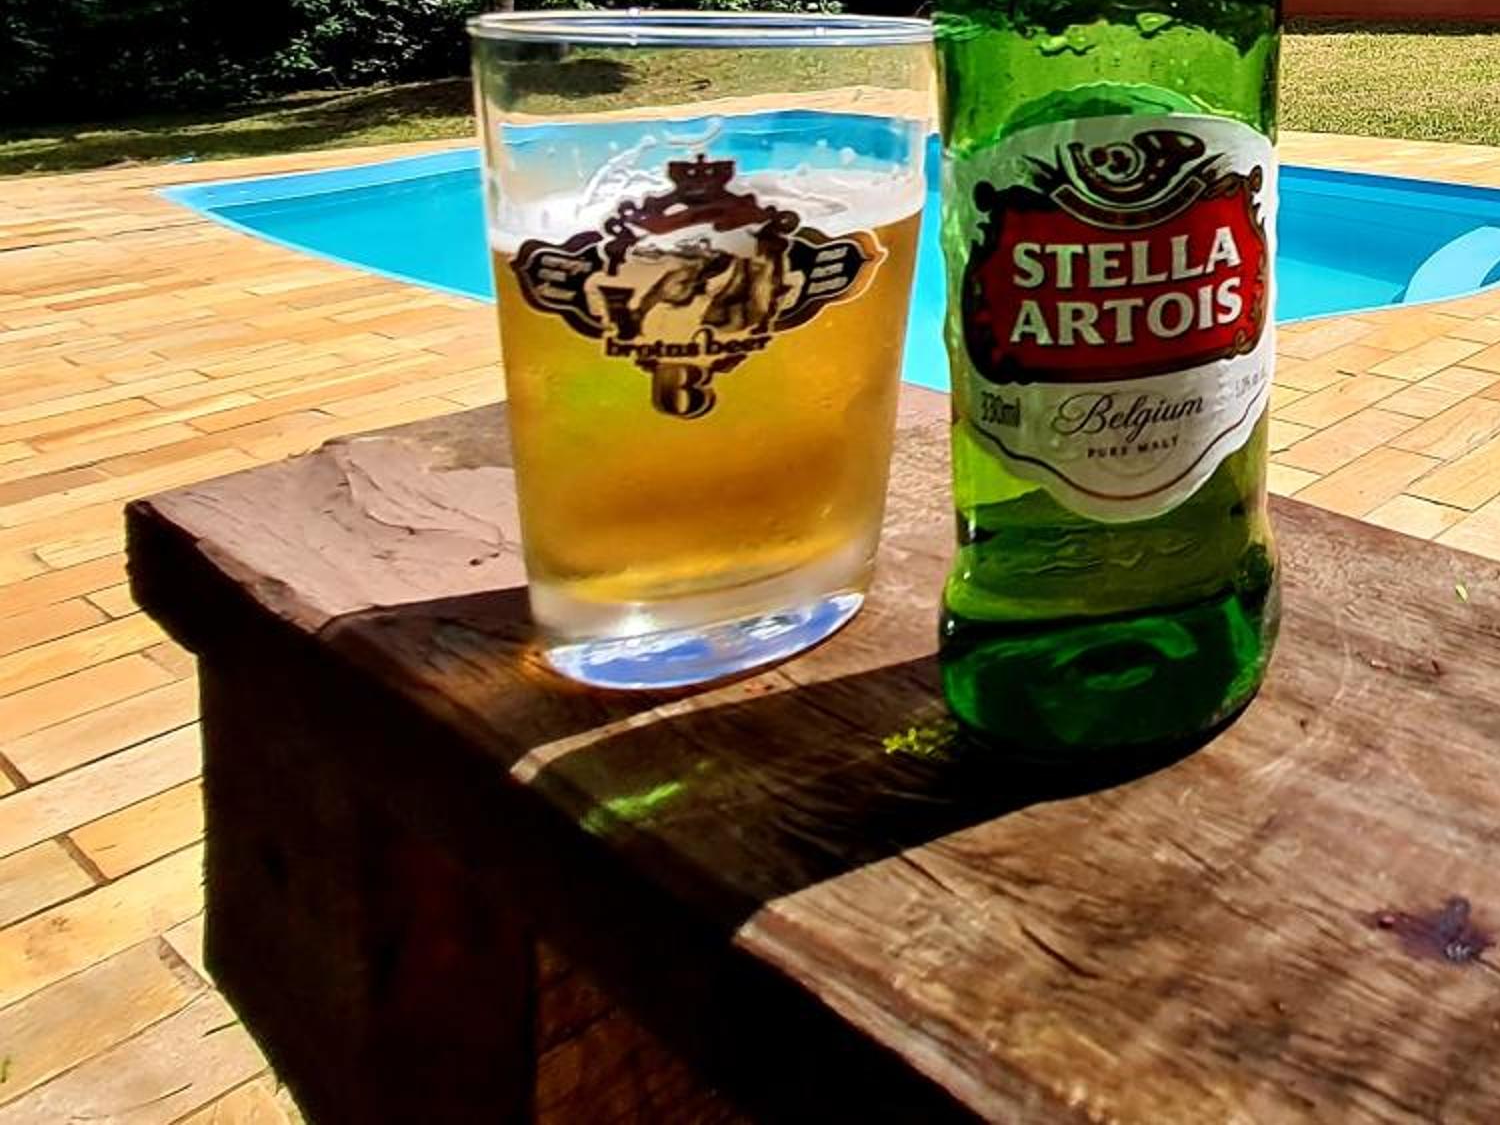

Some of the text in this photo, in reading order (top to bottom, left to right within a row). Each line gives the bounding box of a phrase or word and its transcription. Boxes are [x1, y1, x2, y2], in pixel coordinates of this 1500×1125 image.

[1012, 226, 1242, 289] STELLA
[1009, 277, 1244, 347] ARTOIS
[693, 327, 773, 355] beer
[1051, 391, 1204, 443] Belgium
[1087, 434, 1178, 458] PURE MALT
